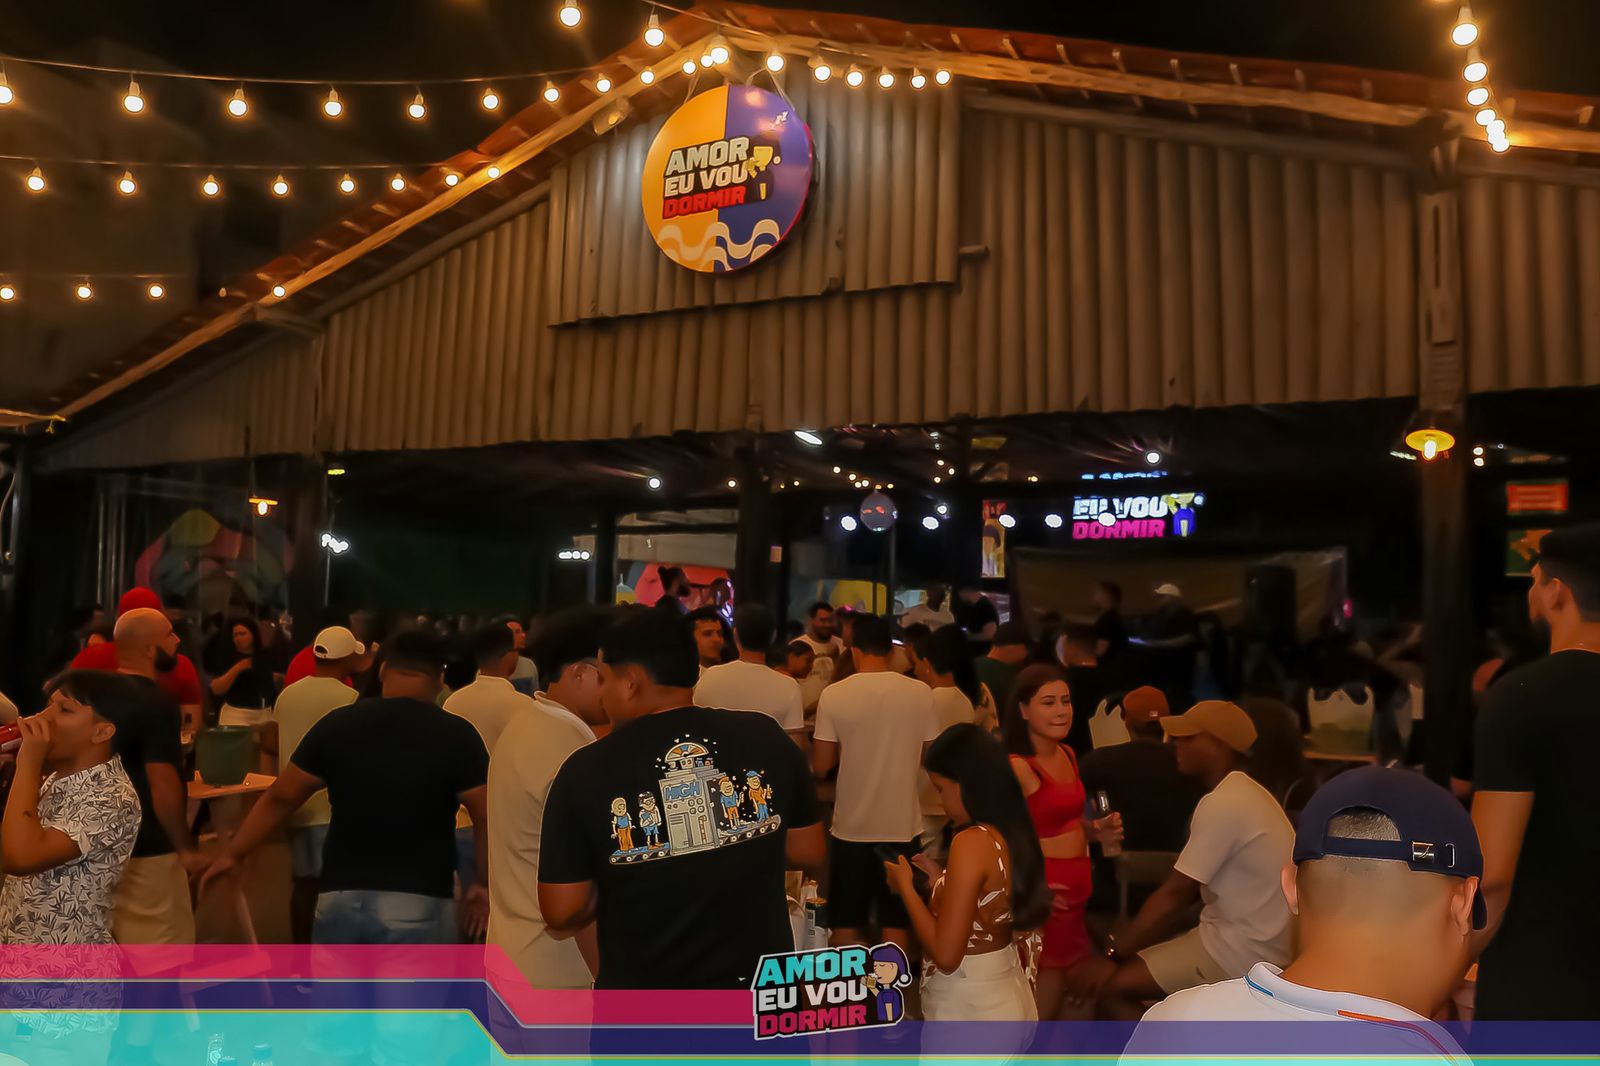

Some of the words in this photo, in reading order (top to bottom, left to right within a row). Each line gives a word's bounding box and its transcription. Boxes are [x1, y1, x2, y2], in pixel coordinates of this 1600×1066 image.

[665, 137, 749, 176] AMOR
[664, 174, 695, 197] EU
[700, 163, 748, 190] VOU
[663, 186, 746, 219] DORMIR
[1073, 498, 1108, 520] EU
[1112, 496, 1168, 519] VOU
[1072, 519, 1166, 539] DORMIR
[664, 782, 701, 800] HIGH
